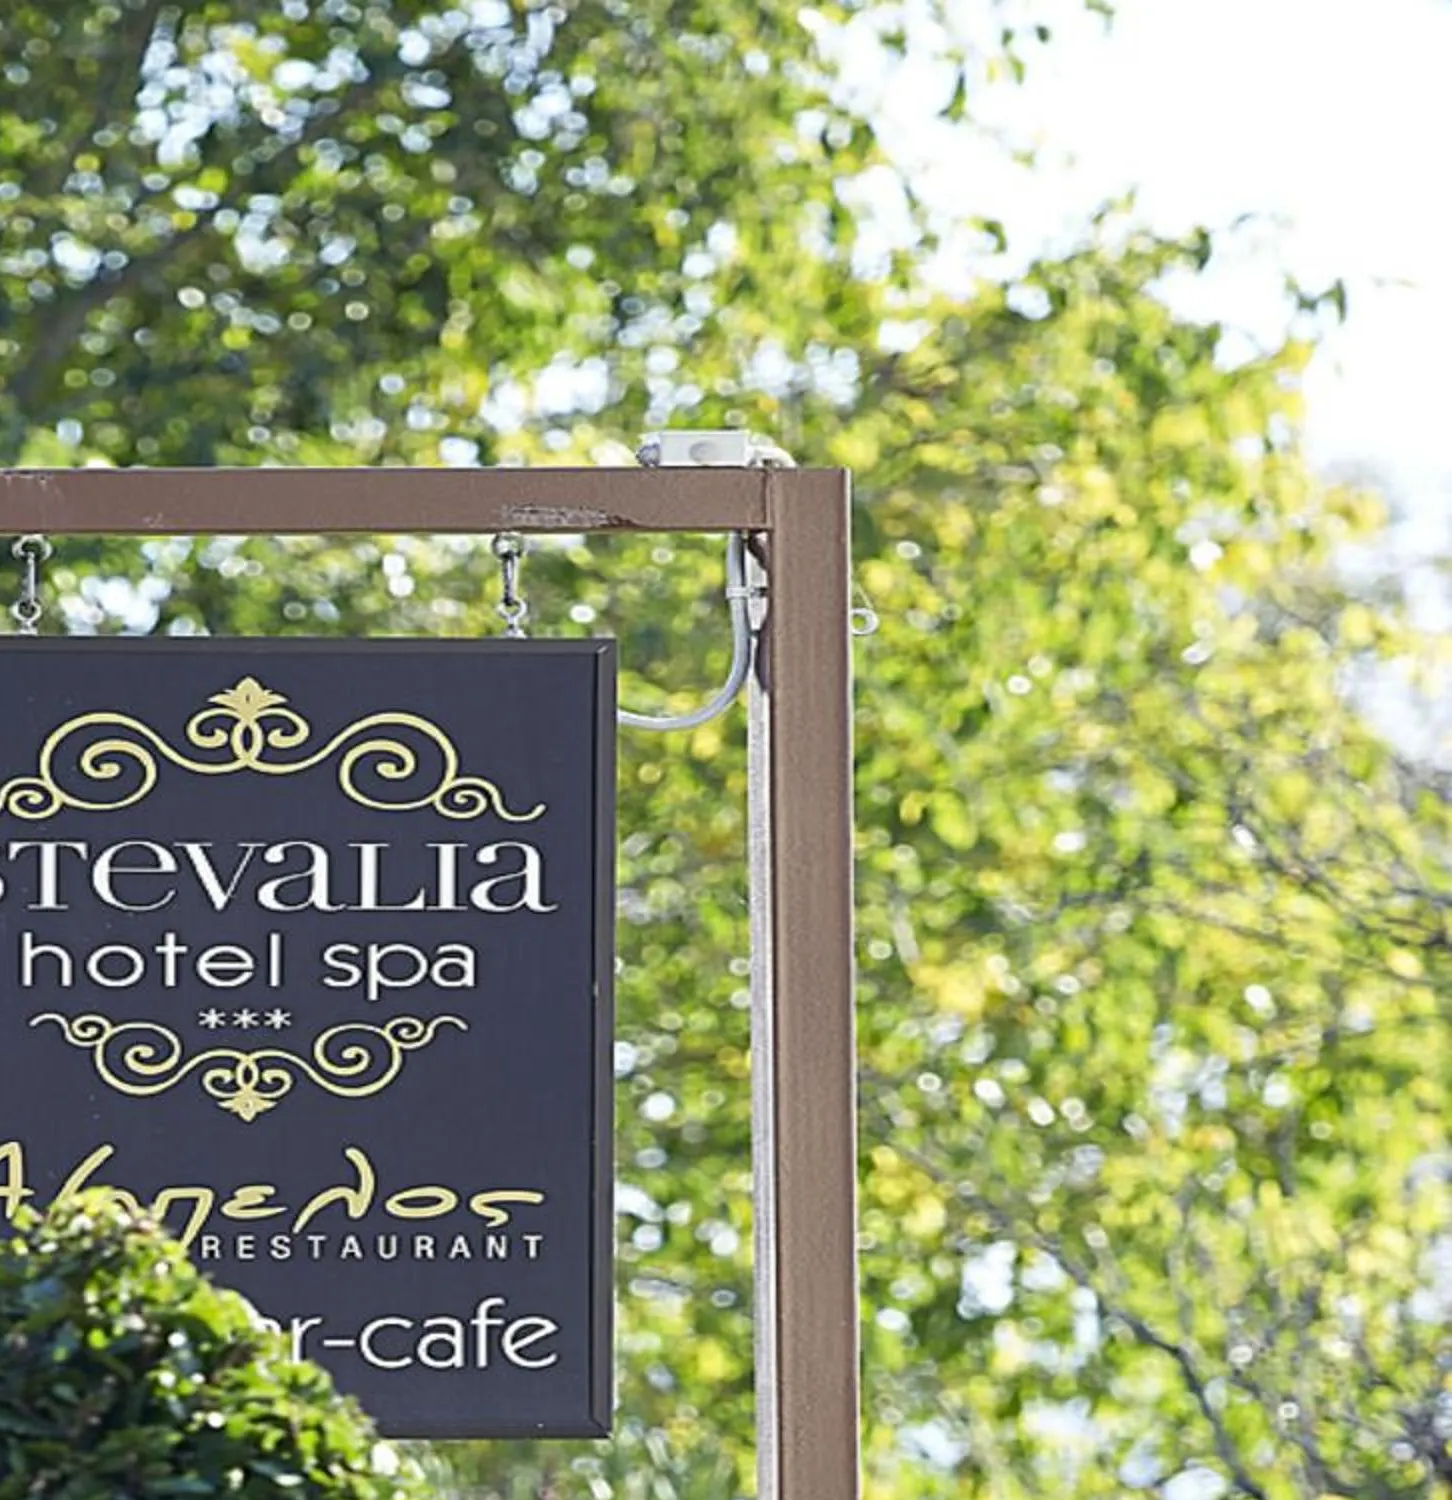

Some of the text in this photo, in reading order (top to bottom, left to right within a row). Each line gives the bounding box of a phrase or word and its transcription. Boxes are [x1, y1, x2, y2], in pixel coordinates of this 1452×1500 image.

[22, 931, 476, 1001] hotel spa
[200, 1234, 545, 1260] RESTAURANT
[258, 1297, 559, 1370] r-cafe
